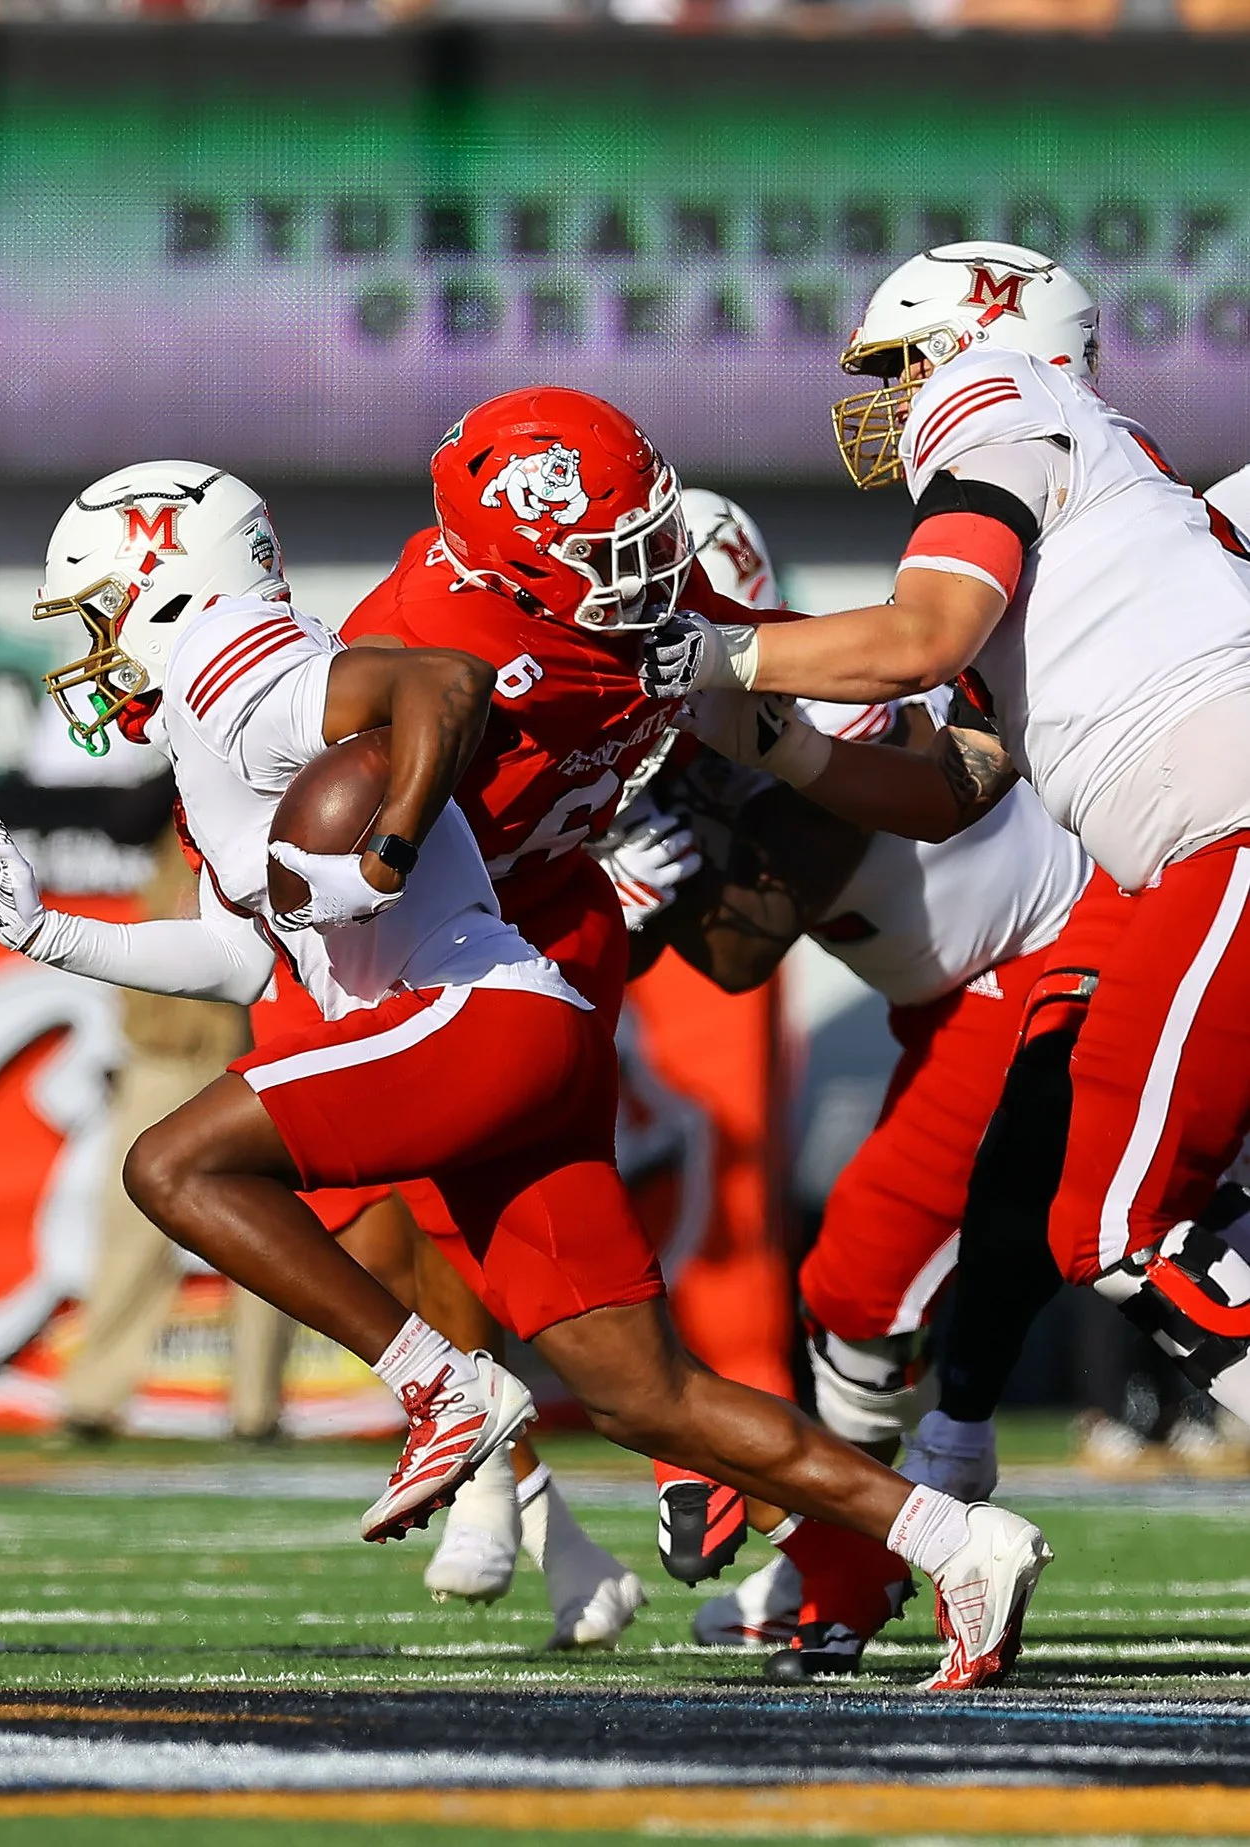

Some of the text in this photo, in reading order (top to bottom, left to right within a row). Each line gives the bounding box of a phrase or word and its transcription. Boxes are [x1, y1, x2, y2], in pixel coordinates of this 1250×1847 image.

[963, 266, 1029, 316] M
[119, 505, 183, 554] M
[495, 653, 544, 699] 6
